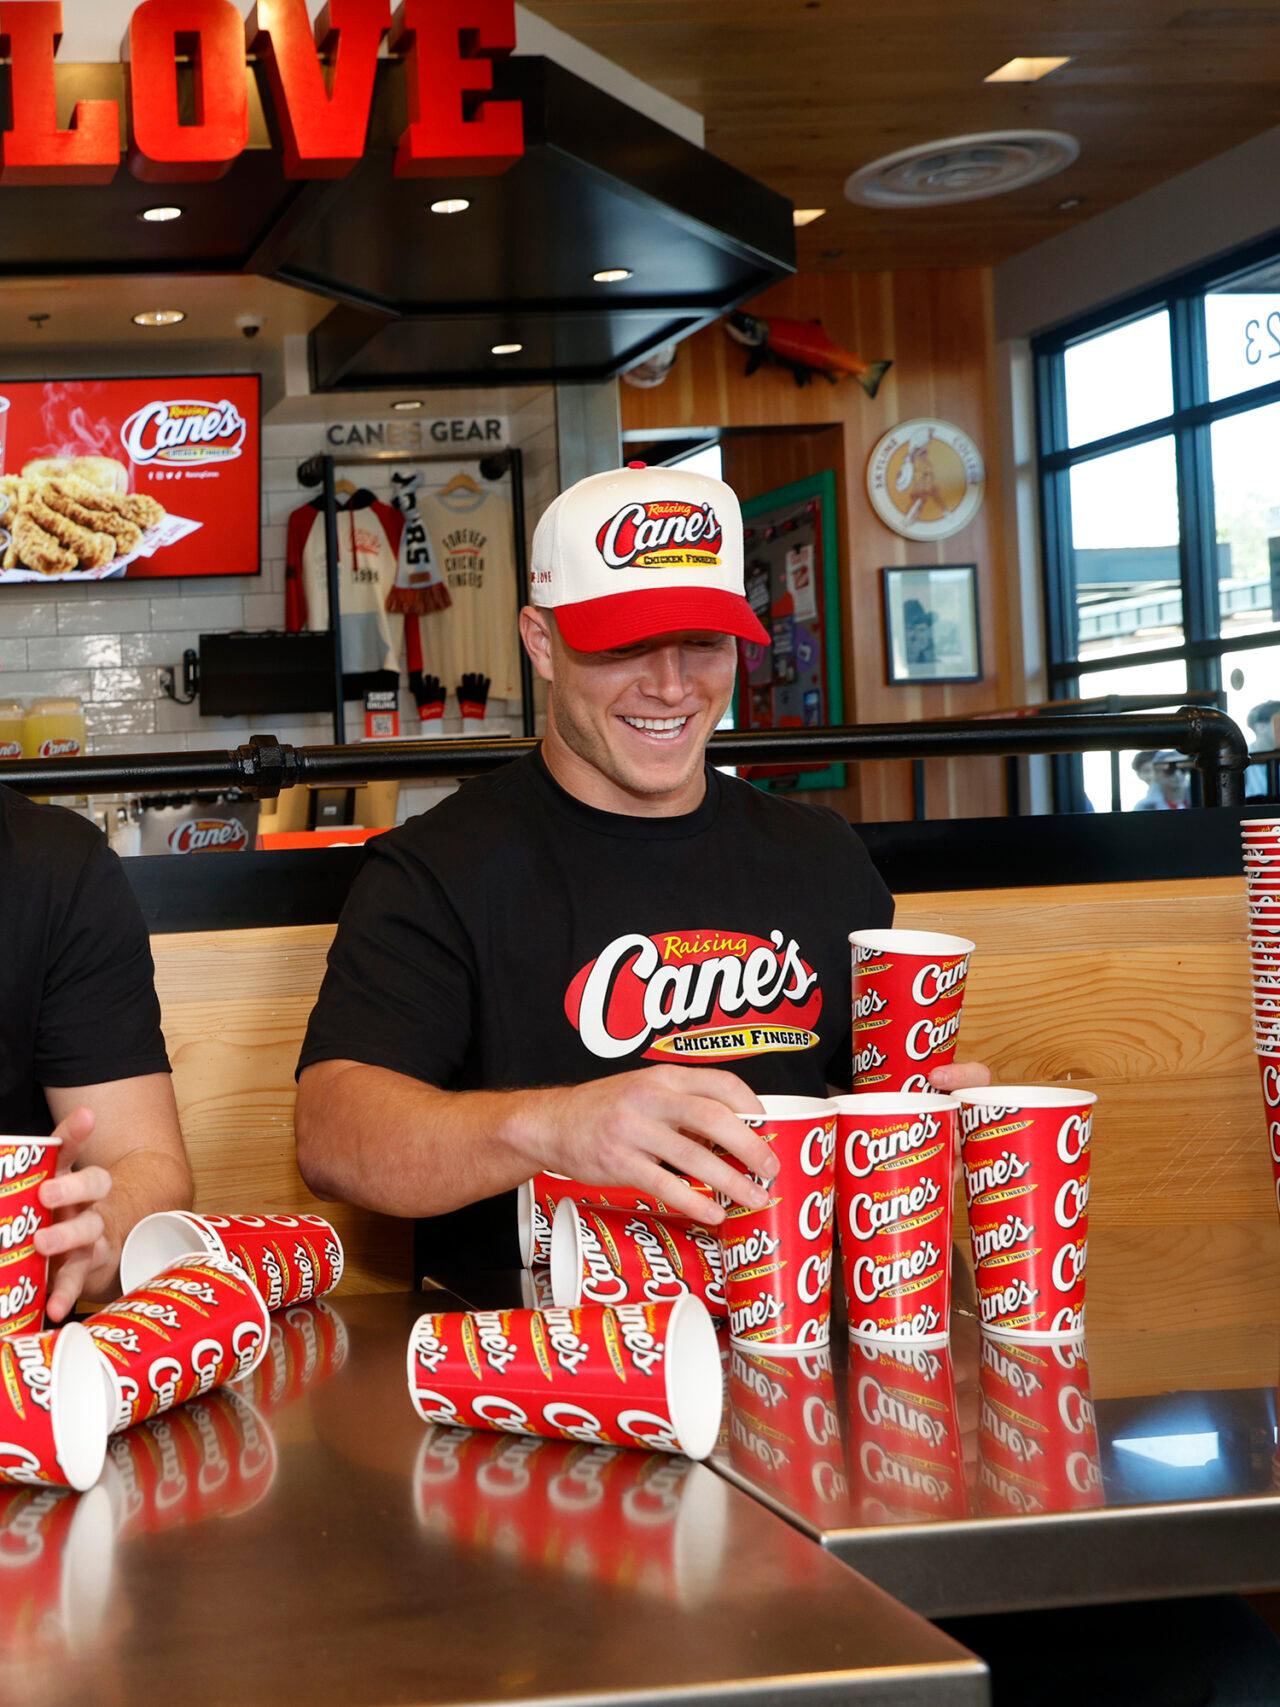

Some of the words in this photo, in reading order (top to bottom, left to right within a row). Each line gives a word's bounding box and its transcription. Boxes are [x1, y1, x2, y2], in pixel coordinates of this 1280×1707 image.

[129, 400, 241, 460] Cane's
[431, 419, 501, 442] GEAR
[648, 503, 692, 516] Raising
[603, 503, 721, 566] Cane's
[644, 555, 684, 564] CHICKEN
[664, 934, 748, 960] Raising
[578, 929, 817, 1059] Cane's
[673, 1033, 744, 1052] CHICKEN
[750, 1030, 809, 1046] FINGERS
[845, 1113, 942, 1177] Cane's
[871, 1121, 910, 1138] Raising
[849, 1177, 941, 1241] Cane's
[873, 1185, 911, 1202] Raising
[625, 1218, 689, 1301] Cane's
[724, 1229, 779, 1272] ane's
[875, 1249, 911, 1266] Raising
[853, 1241, 940, 1303] Cane's
[731, 1292, 784, 1336] ane's
[878, 1312, 912, 1328] Raising
